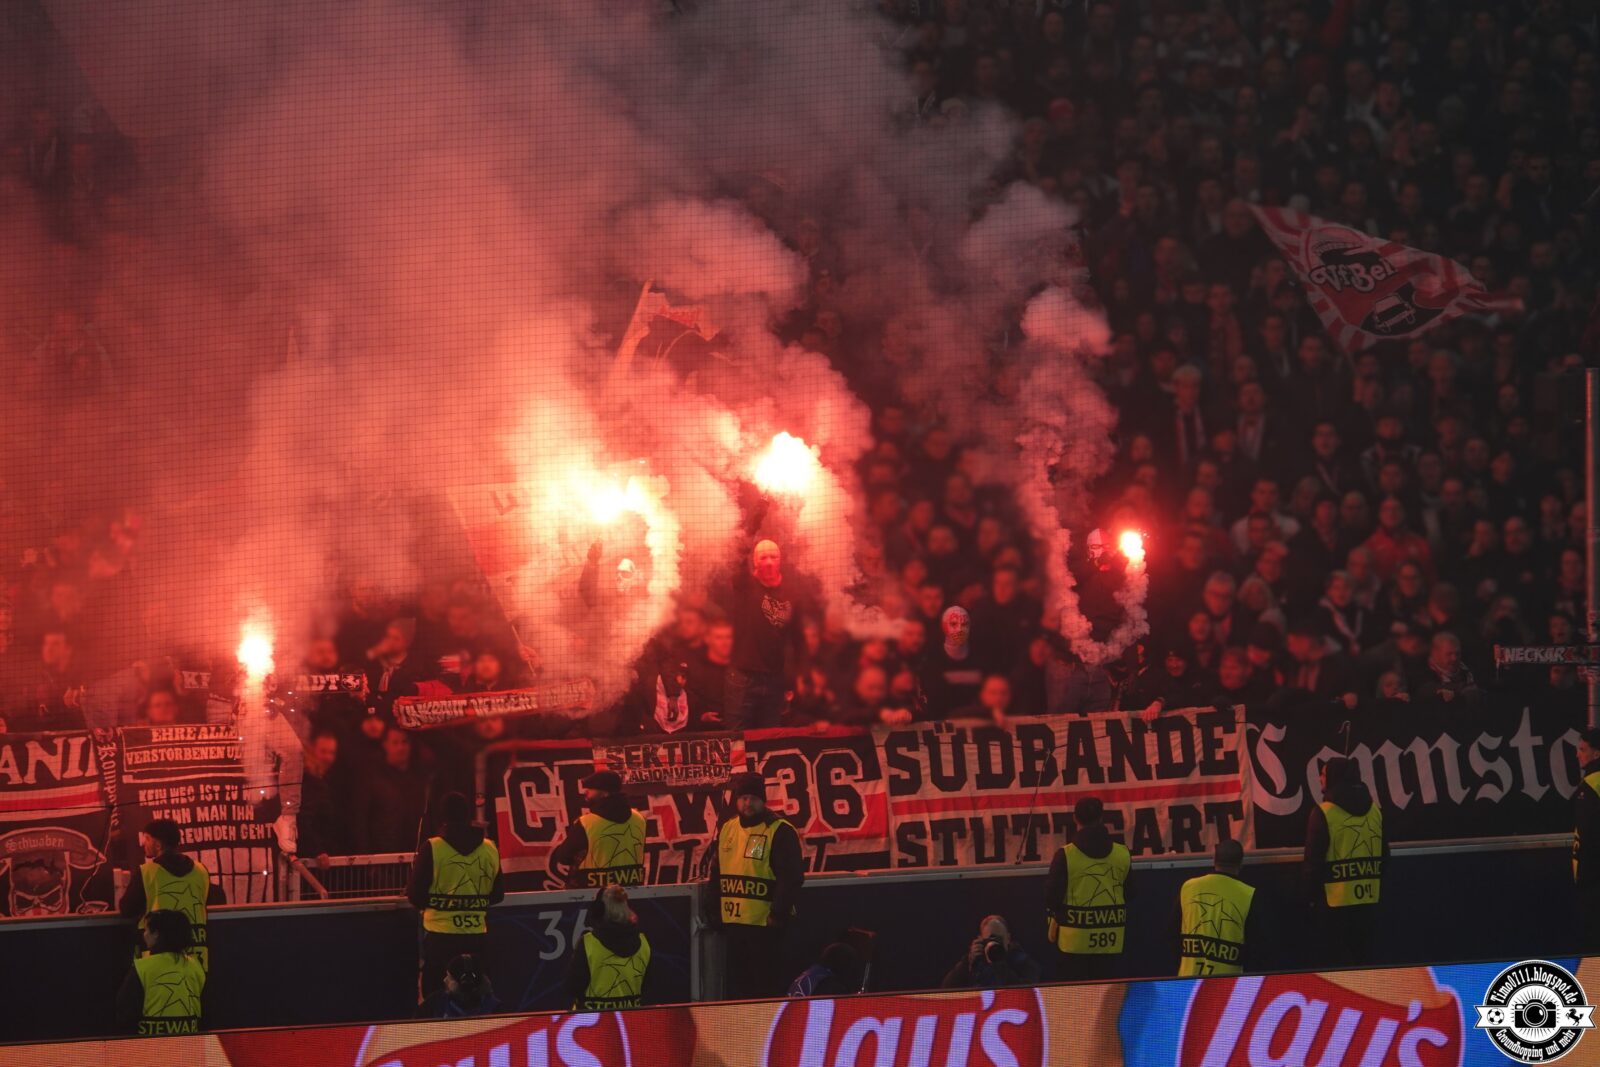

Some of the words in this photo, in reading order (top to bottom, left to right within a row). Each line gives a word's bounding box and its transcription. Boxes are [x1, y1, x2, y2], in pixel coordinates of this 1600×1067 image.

[1504, 647, 1564, 663] NECKAR
[152, 728, 197, 743] EHRE
[197, 726, 239, 741] ALL
[126, 746, 225, 766] VERSTORBENEN
[606, 738, 732, 770] SEKTION
[885, 711, 1240, 797] SÜDBANDE
[96, 741, 120, 826] Kompaie
[139, 789, 168, 807] KEIN
[170, 786, 195, 805] WEG
[200, 784, 220, 801] IST
[225, 784, 238, 801] ZU
[152, 807, 191, 825] WENN
[196, 805, 227, 822] MAN
[232, 805, 255, 821] IHN
[5, 834, 65, 852] Schwaben
[179, 825, 236, 845] REUNDEN
[240, 823, 272, 840] GEHT
[453, 915, 481, 927] 053
[1089, 932, 1117, 948] 589
